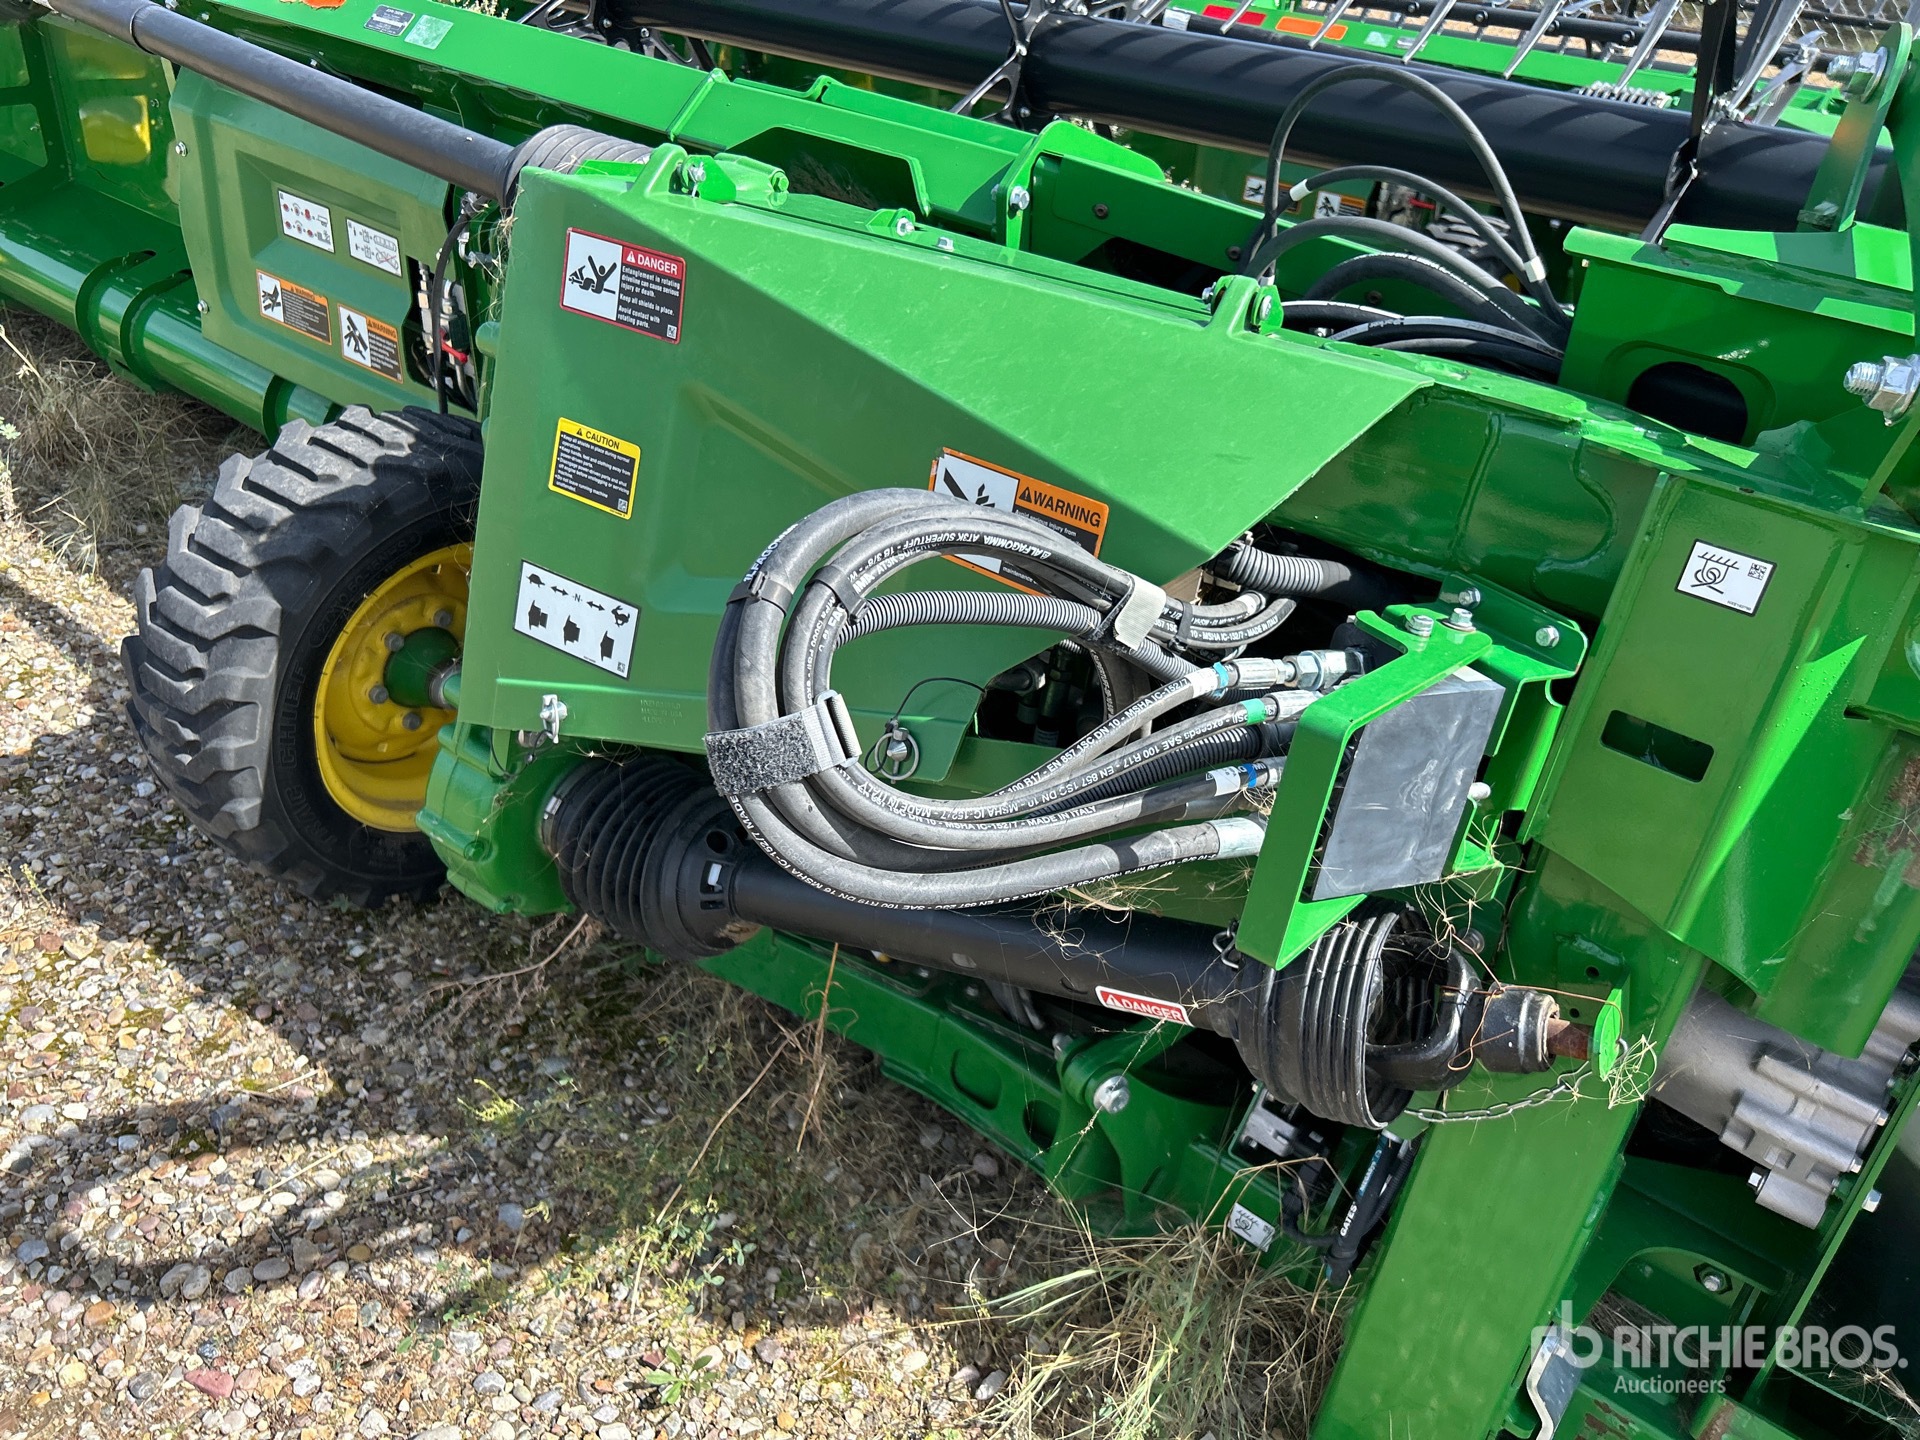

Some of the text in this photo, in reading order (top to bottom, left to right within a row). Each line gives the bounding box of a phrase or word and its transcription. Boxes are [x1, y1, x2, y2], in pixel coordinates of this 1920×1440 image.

[638, 254, 677, 275] DANGER
[622, 266, 654, 281] Entanglement
[661, 278, 680, 290] rotating
[621, 282, 634, 292] injury
[650, 283, 662, 291] cause
[663, 287, 679, 297] serious
[618, 305, 631, 314] Avoid
[632, 310, 649, 320] contact
[620, 293, 631, 302] Keep
[639, 299, 654, 309] shields
[660, 306, 674, 316] place.
[617, 314, 636, 325] rotating
[585, 430, 620, 450] CAUTION
[1034, 490, 1101, 528] WARNING
[1049, 522, 1064, 532] injury
[1064, 528, 1077, 536] from
[902, 532, 956, 550] SUPERTUFF
[984, 534, 1044, 558] ALFAGOMMA
[280, 665, 306, 770] CHIEF
[1047, 760, 1062, 772] EN
[1060, 749, 1076, 763] 857
[1076, 738, 1095, 752] 1SC
[1093, 726, 1109, 740] DN
[1108, 718, 1120, 729] 10
[1125, 698, 1154, 720] MSHA
[1151, 678, 1190, 700] IC-152/7
[1163, 735, 1182, 750] SAE
[1143, 746, 1160, 758] 100
[1124, 754, 1141, 768] R17
[1082, 773, 1098, 786] 857
[1100, 766, 1114, 779] EN
[1042, 790, 1057, 803] DN
[1059, 781, 1079, 795] 1SC
[730, 795, 754, 830] MADE
[901, 802, 931, 818] MADE
[977, 820, 1018, 831] IC-152/7
[1028, 814, 1058, 827] MADE
[1058, 810, 1070, 821] IN
[1071, 805, 1097, 818] ITALY
[987, 804, 1018, 817] MSHA
[752, 831, 791, 869] IC-152/7
[791, 868, 823, 889] MSHA
[838, 893, 854, 902] DN
[1122, 999, 1183, 1021] DANGER
[1340, 1204, 1357, 1236] GATES
